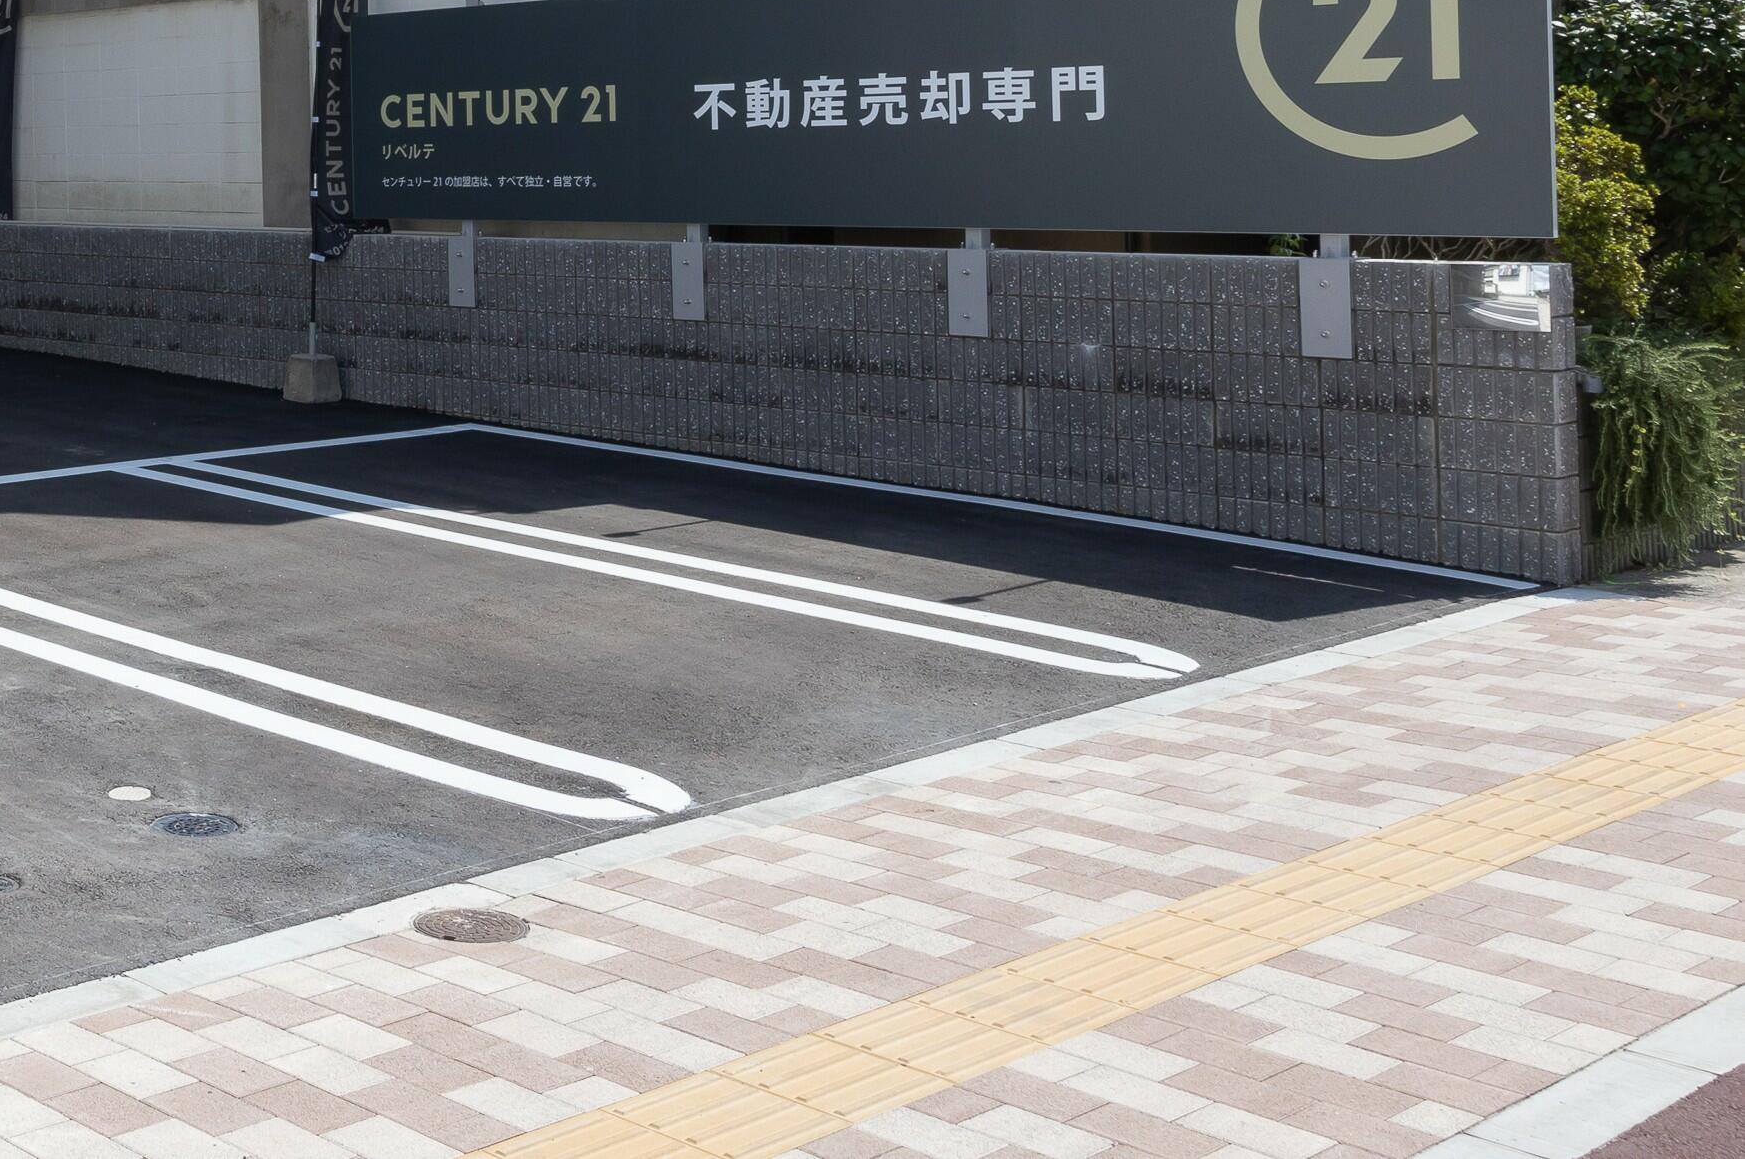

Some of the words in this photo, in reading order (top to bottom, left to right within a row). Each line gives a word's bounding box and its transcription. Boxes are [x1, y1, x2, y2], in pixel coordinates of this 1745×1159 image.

[329, 46, 343, 71] 21
[380, 86, 569, 129] CENTURY
[580, 84, 617, 123] 21
[692, 64, 1106, 131] 不動産売却専門
[325, 78, 350, 215] CENTURY
[382, 143, 435, 160] リベルテ
